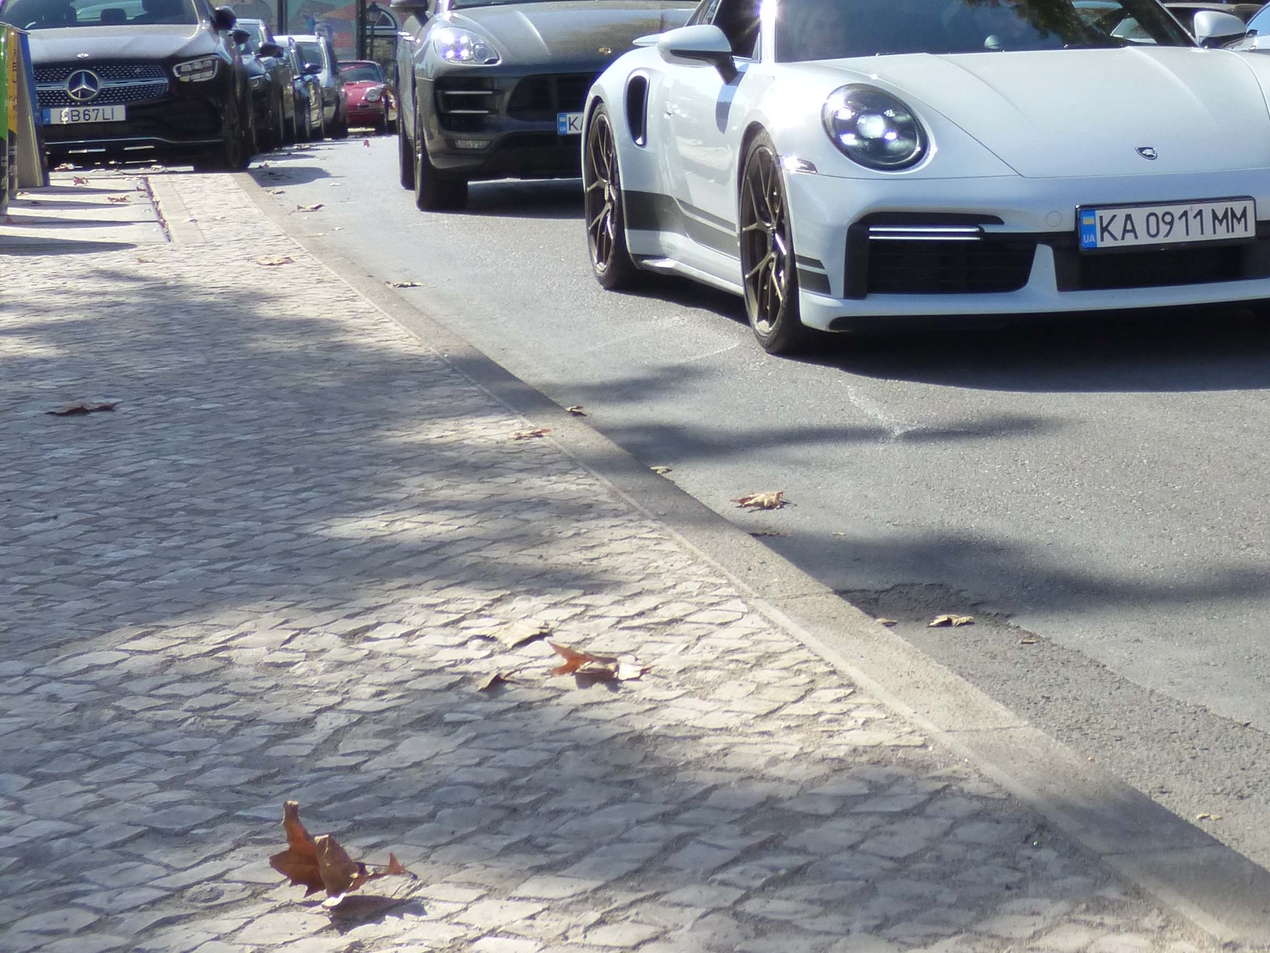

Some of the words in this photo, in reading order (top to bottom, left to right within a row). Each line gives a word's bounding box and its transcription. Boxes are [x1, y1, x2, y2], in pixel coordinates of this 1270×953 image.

[1099, 213, 1138, 242] KA
[1146, 209, 1204, 238] 0911
[1211, 206, 1248, 235] MM
[1083, 234, 1096, 243] UA
